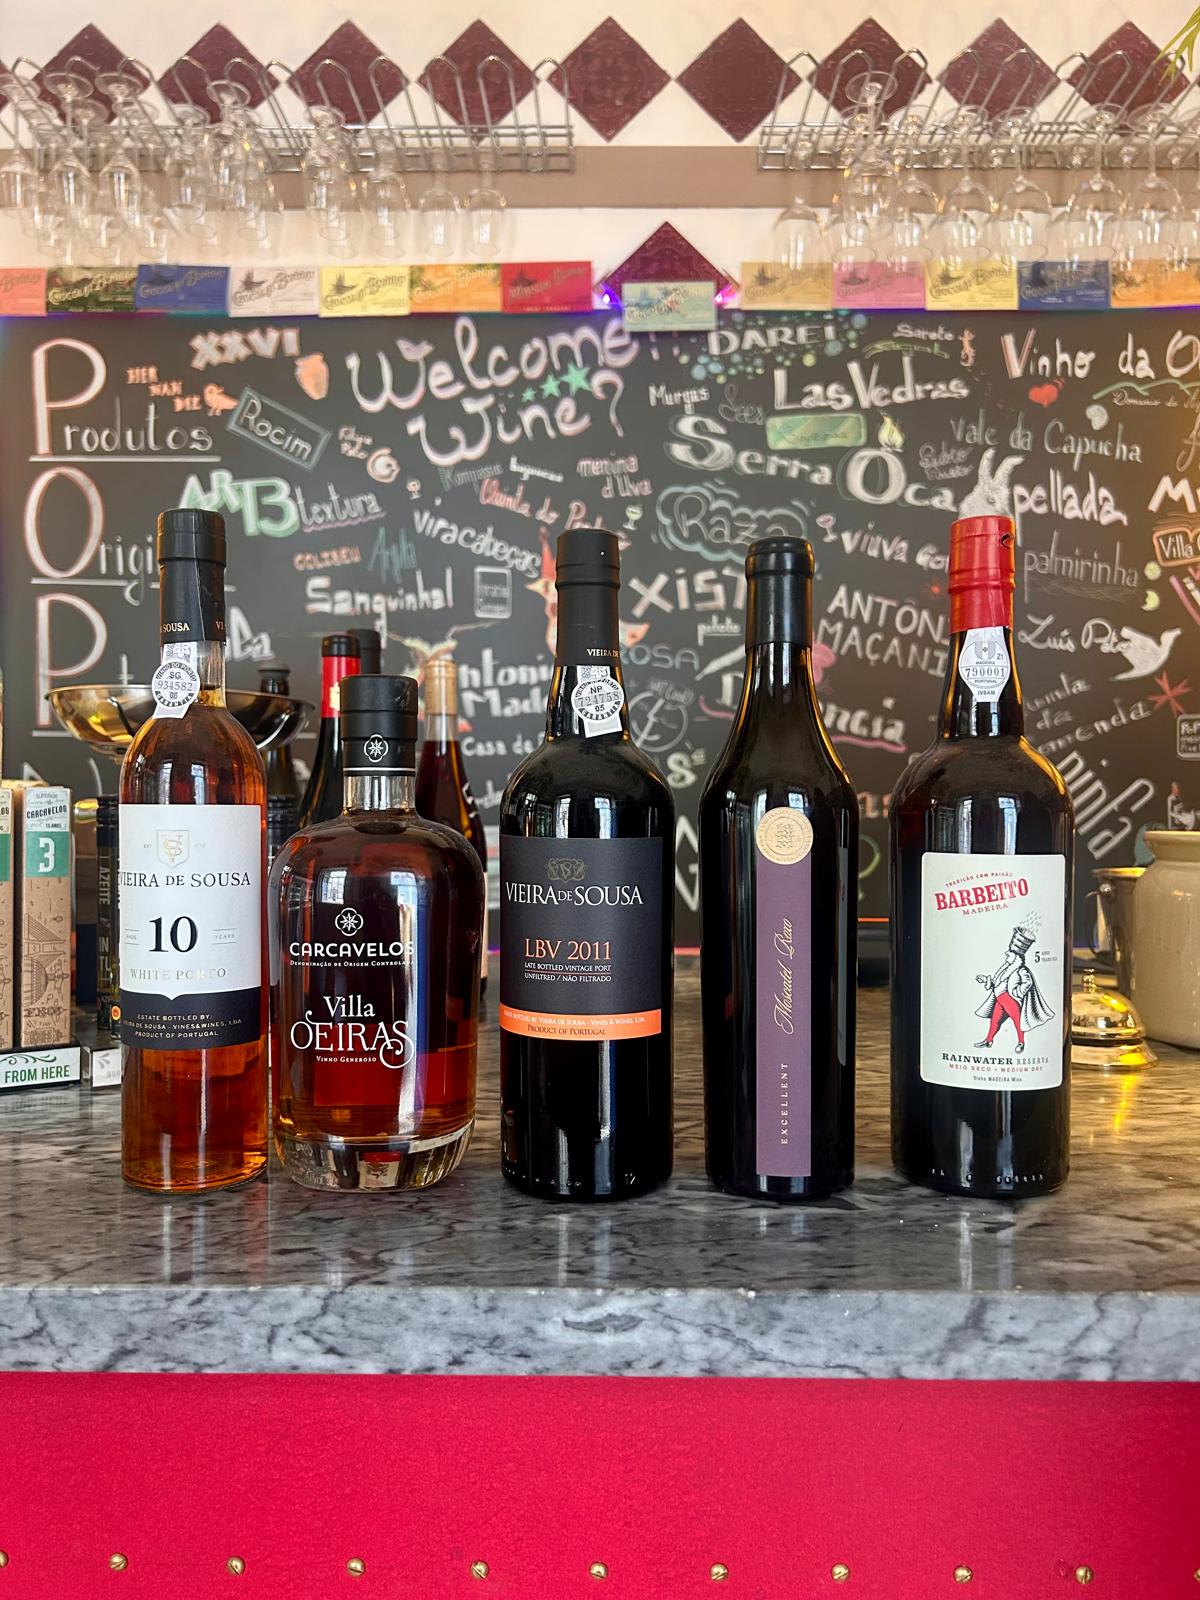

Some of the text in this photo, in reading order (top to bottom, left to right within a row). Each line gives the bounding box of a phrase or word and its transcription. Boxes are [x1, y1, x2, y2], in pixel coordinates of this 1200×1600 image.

[1000, 328, 1096, 380] Vinho
[1118, 332, 1156, 380] da
[344, 316, 640, 413] Welcome
[32, 338, 214, 454] Produtos
[405, 369, 625, 466] Wine?
[663, 415, 833, 486] Serra
[1009, 411, 1034, 451] da
[1044, 418, 1144, 473] Capucha
[1023, 529, 1141, 603] palmirinha
[162, 621, 190, 633] SOUSA
[586, 648, 612, 658] VIEIRA
[815, 617, 950, 680] MAÇANI
[965, 667, 1005, 678] 790001
[590, 686, 603, 695] NP
[26, 804, 68, 820] CARCAVELOS
[38, 836, 56, 873] 3
[99, 866, 111, 906] AZEITE
[165, 875, 186, 886] DE
[190, 871, 252, 888] SOUSA
[505, 881, 644, 907] VIEIRA DE SOUSA
[934, 878, 1029, 911] BARBEITO
[962, 902, 1009, 916] MADEIRA
[148, 915, 199, 953] 10
[289, 941, 415, 959] CARCAVELOS
[524, 938, 612, 961] LBV 2011
[1034, 951, 1041, 964] 5
[129, 967, 226, 981] WHITE PORTO
[524, 961, 612, 973] LATE BOTTLED VINTAGE PORT
[524, 972, 612, 983] UNFILTRED NÃO FILTRADO
[323, 995, 376, 1019] Villa
[774, 959, 794, 1035] Moscatel
[136, 1013, 161, 1022] ESTATE
[162, 1013, 198, 1022] BOTTLED
[144, 1022, 167, 1030] SOUSA
[134, 1030, 219, 1039] PRODUCT OF PORTUGAL
[290, 1010, 415, 1070] OEIRAS
[941, 1052, 1050, 1066] RAINWATER RESERVA
[949, 1062, 968, 1070] MEIO
[970, 1064, 992, 1072] SECO
[4, 1064, 71, 1084] FROM HERE
[987, 1075, 1010, 1083] MADEIRA
[781, 1062, 789, 1144] EXCELLENT
